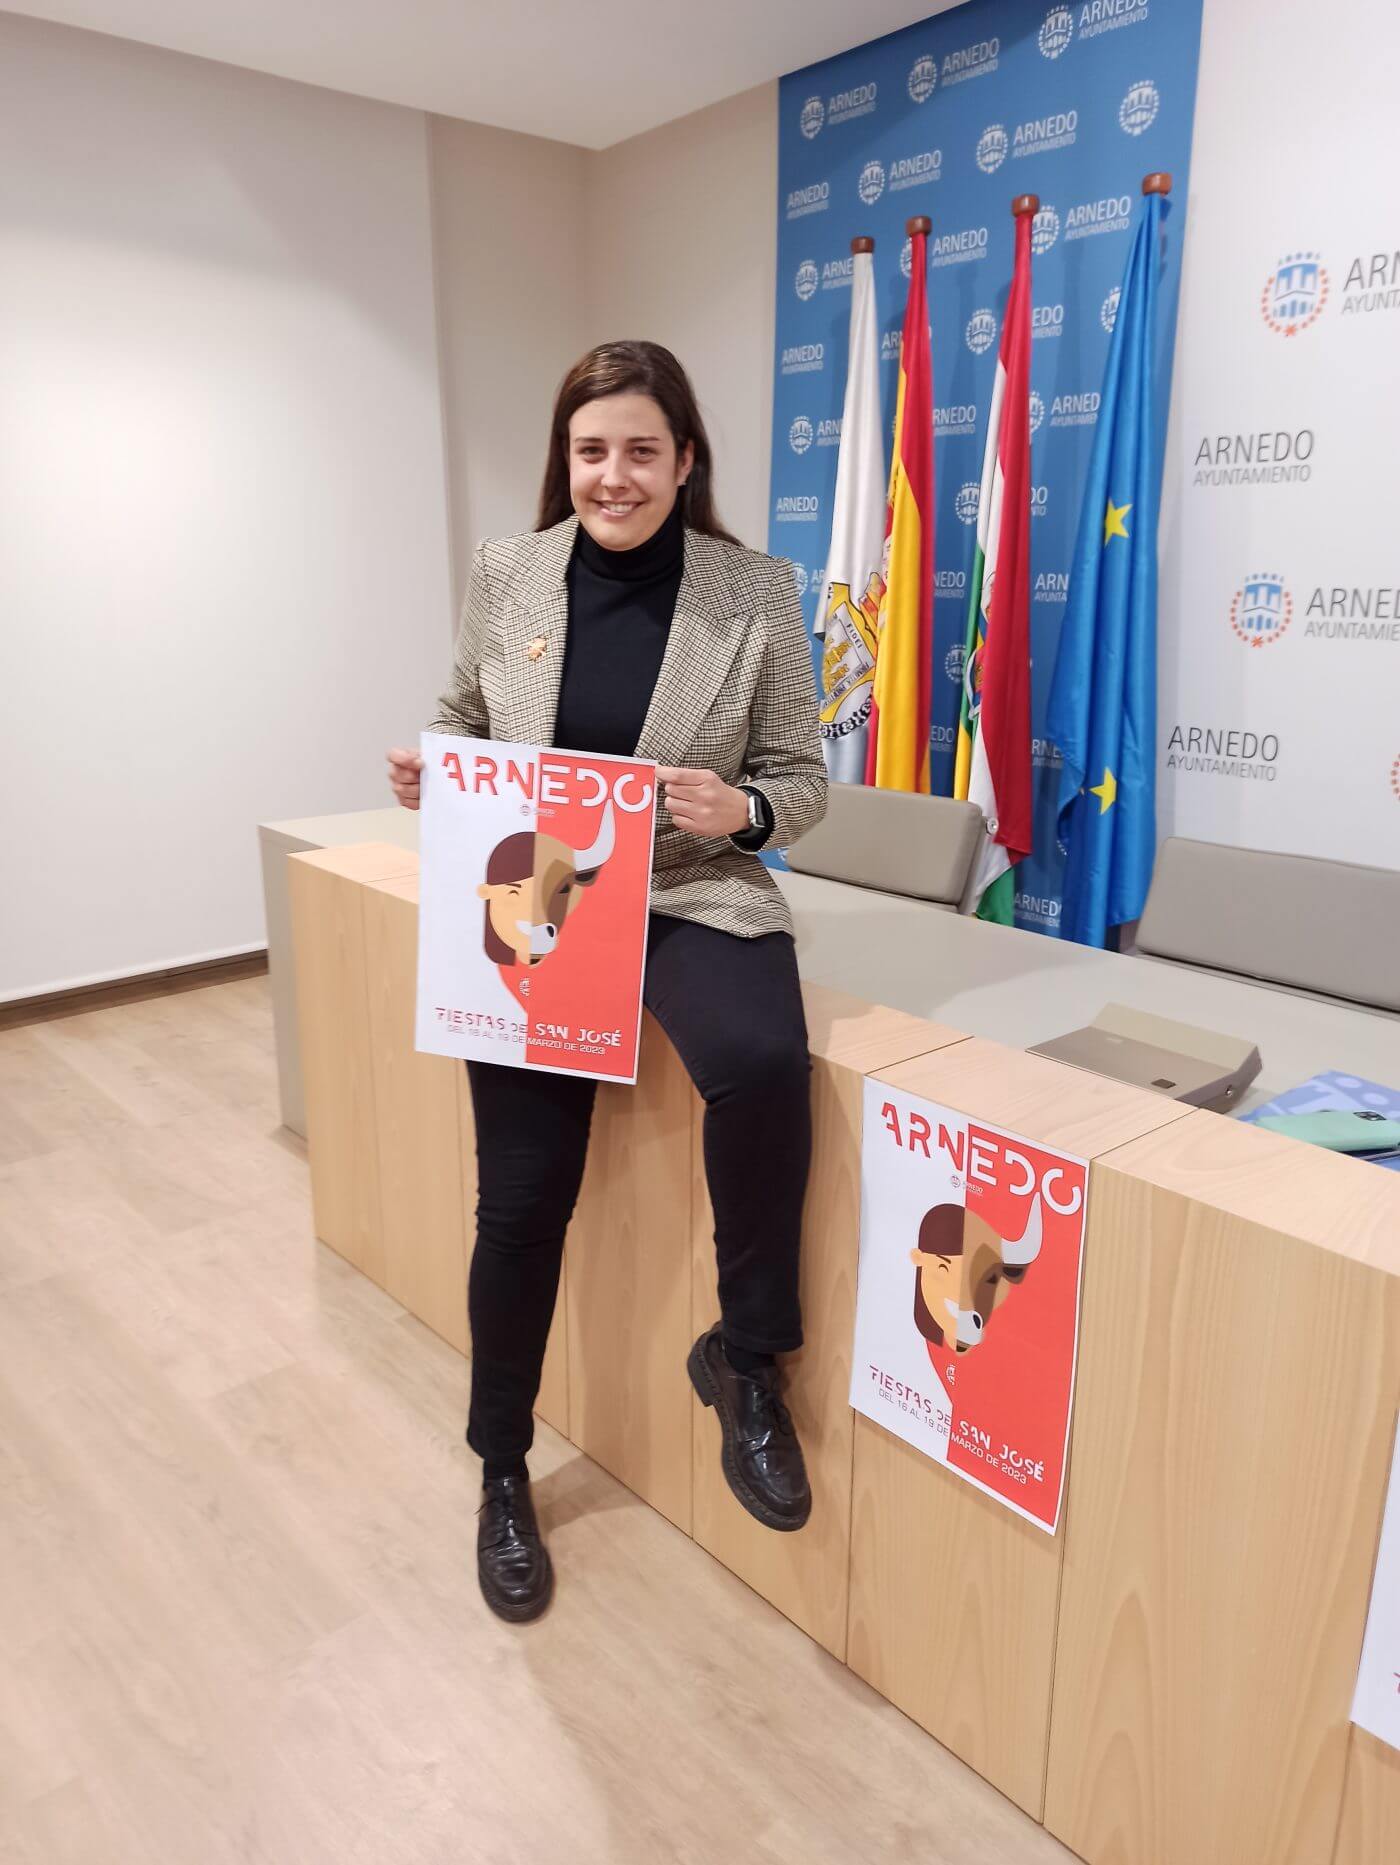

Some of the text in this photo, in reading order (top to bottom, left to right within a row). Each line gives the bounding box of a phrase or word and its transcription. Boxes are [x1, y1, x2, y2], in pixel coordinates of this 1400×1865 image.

[942, 38, 999, 76] ARNEDO
[828, 82, 877, 113] ARNEDO
[1013, 110, 1077, 145] ARNEDO
[889, 150, 941, 179] ARNEDO
[787, 182, 829, 208] ARNEDO
[1065, 196, 1131, 228] ARNEDO
[932, 227, 988, 256] ARNEDO
[823, 257, 853, 279] ARNE
[1032, 304, 1063, 327] EDO
[782, 344, 824, 363] ARNEDO
[932, 405, 976, 424] RNEDO
[1051, 392, 1101, 415] ARNED
[1195, 429, 1314, 465] ARNEDO
[1194, 465, 1312, 487] AYUNTAMIENTO
[776, 496, 818, 512] ARNEDO
[933, 571, 966, 587] NEDO
[1035, 573, 1069, 590] ARN
[1306, 587, 1400, 619] ARNE
[1304, 621, 1400, 641] AYUNTAMIE
[931, 725, 954, 742] EDO
[1168, 725, 1279, 761] ARNEDO
[1167, 754, 1277, 782] AYUNTAMIENTO
[442, 752, 651, 813] ARNEDO
[1015, 893, 1062, 916] ARNED
[435, 1007, 622, 1047] FIESTAS DE SAN JOSÉ
[527, 1037, 562, 1049] MARZO
[564, 1043, 579, 1051] DE
[579, 1044, 606, 1055] 2023
[881, 1102, 1082, 1215] ARNEDO
[869, 1364, 1045, 1482] FIESTAS DE SAN JOSÉ
[878, 1388, 1028, 1485] DEL 16 AL 19 DE MARZO DE 2023
